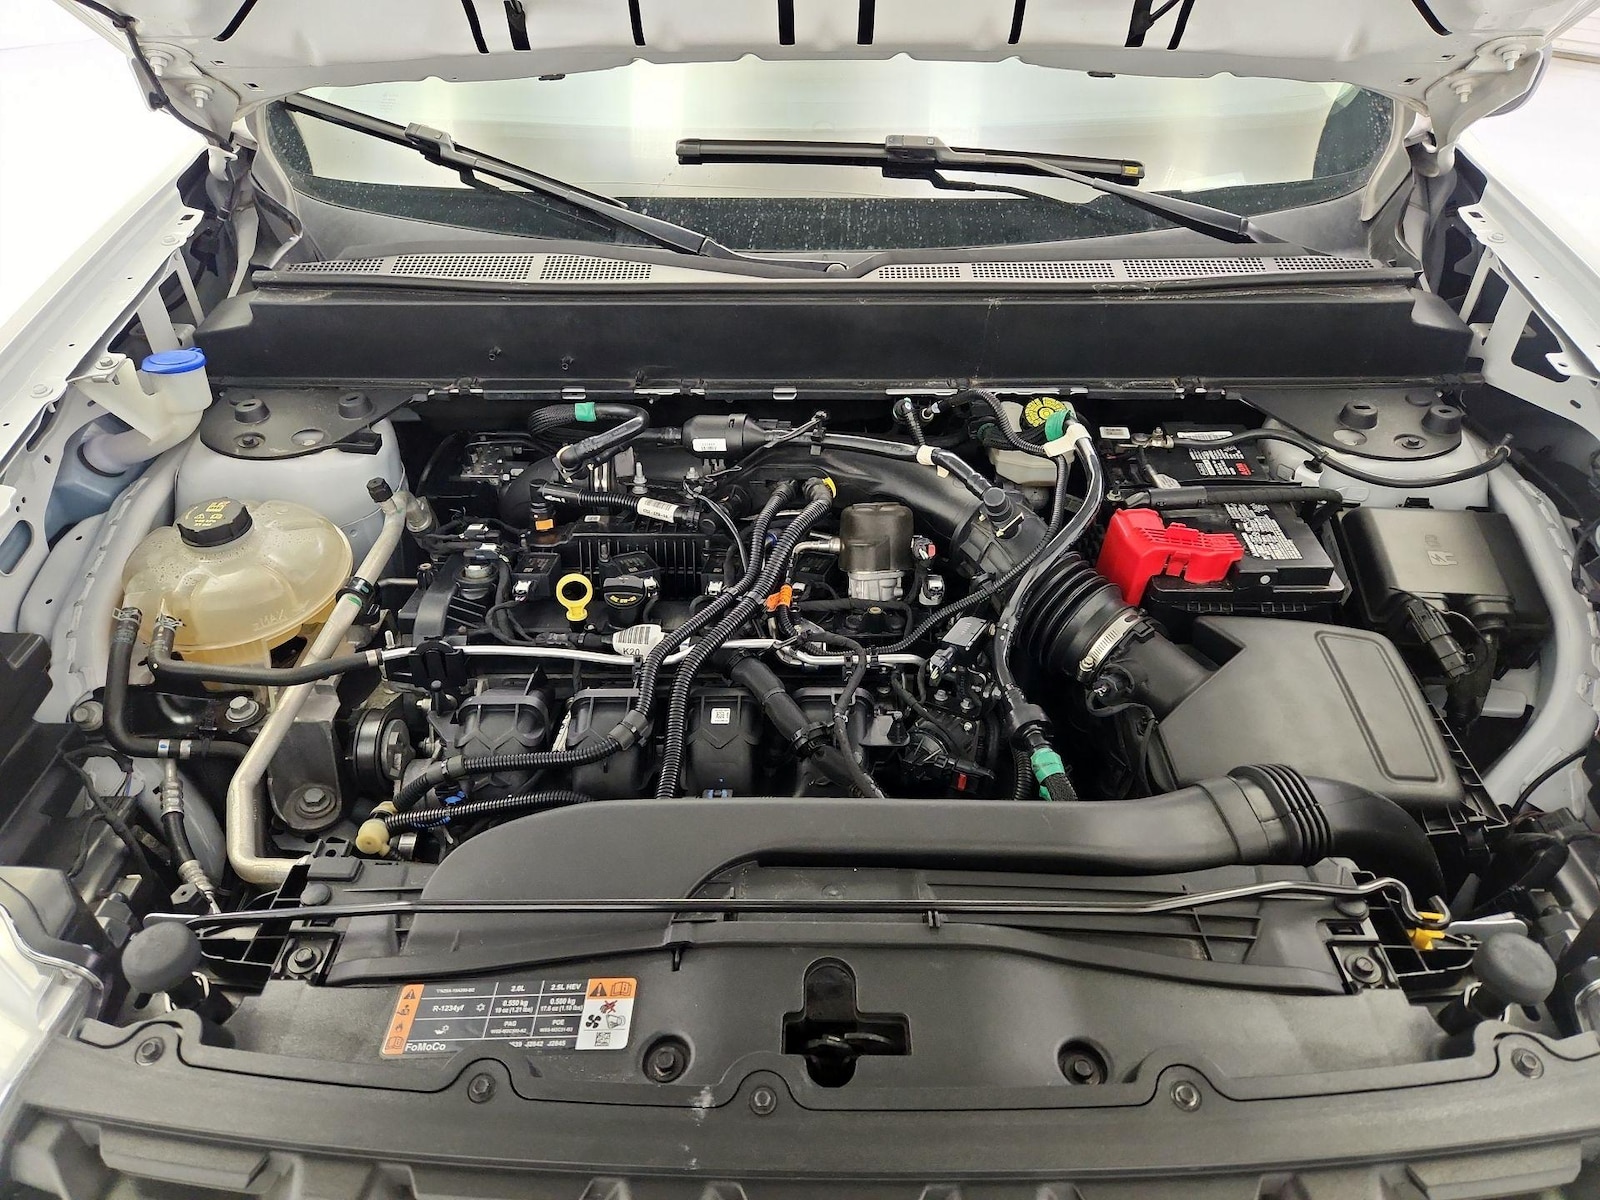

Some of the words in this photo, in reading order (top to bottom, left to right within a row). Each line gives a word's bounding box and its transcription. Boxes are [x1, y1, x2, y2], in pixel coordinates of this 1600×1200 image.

[623, 647, 641, 656] K20
[520, 1000, 529, 1008] kg
[567, 998, 577, 1006] kg
[432, 1004, 465, 1013] R-1234yf
[405, 1042, 446, 1052] FoMoCo
